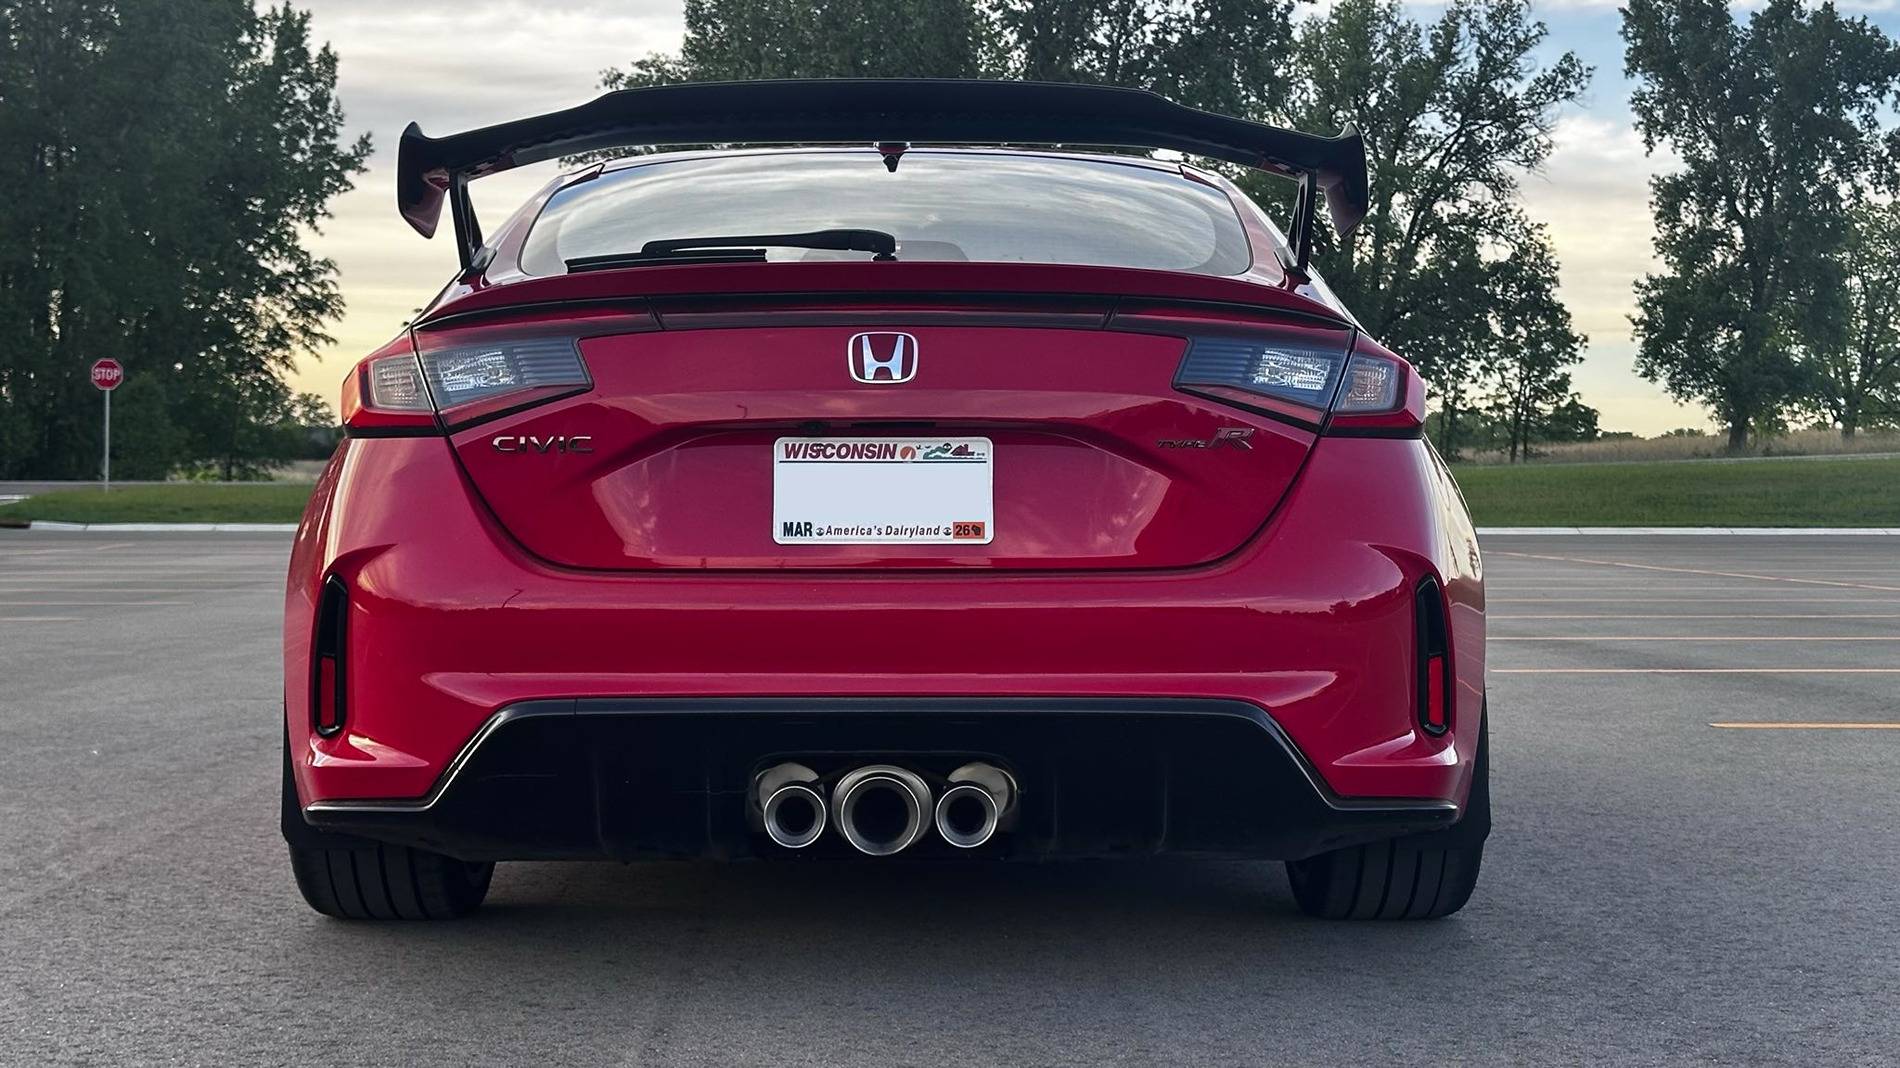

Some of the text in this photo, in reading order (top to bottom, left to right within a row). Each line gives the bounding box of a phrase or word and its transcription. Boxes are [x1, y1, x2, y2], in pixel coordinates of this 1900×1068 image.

[95, 367, 120, 380] STOP
[492, 436, 593, 452] CIVIC
[1158, 427, 1255, 449] TYPE R
[784, 443, 898, 460] WISCONSIN
[783, 521, 813, 537] MAR
[825, 525, 941, 538] America's Dairyland
[955, 524, 970, 536] 26
